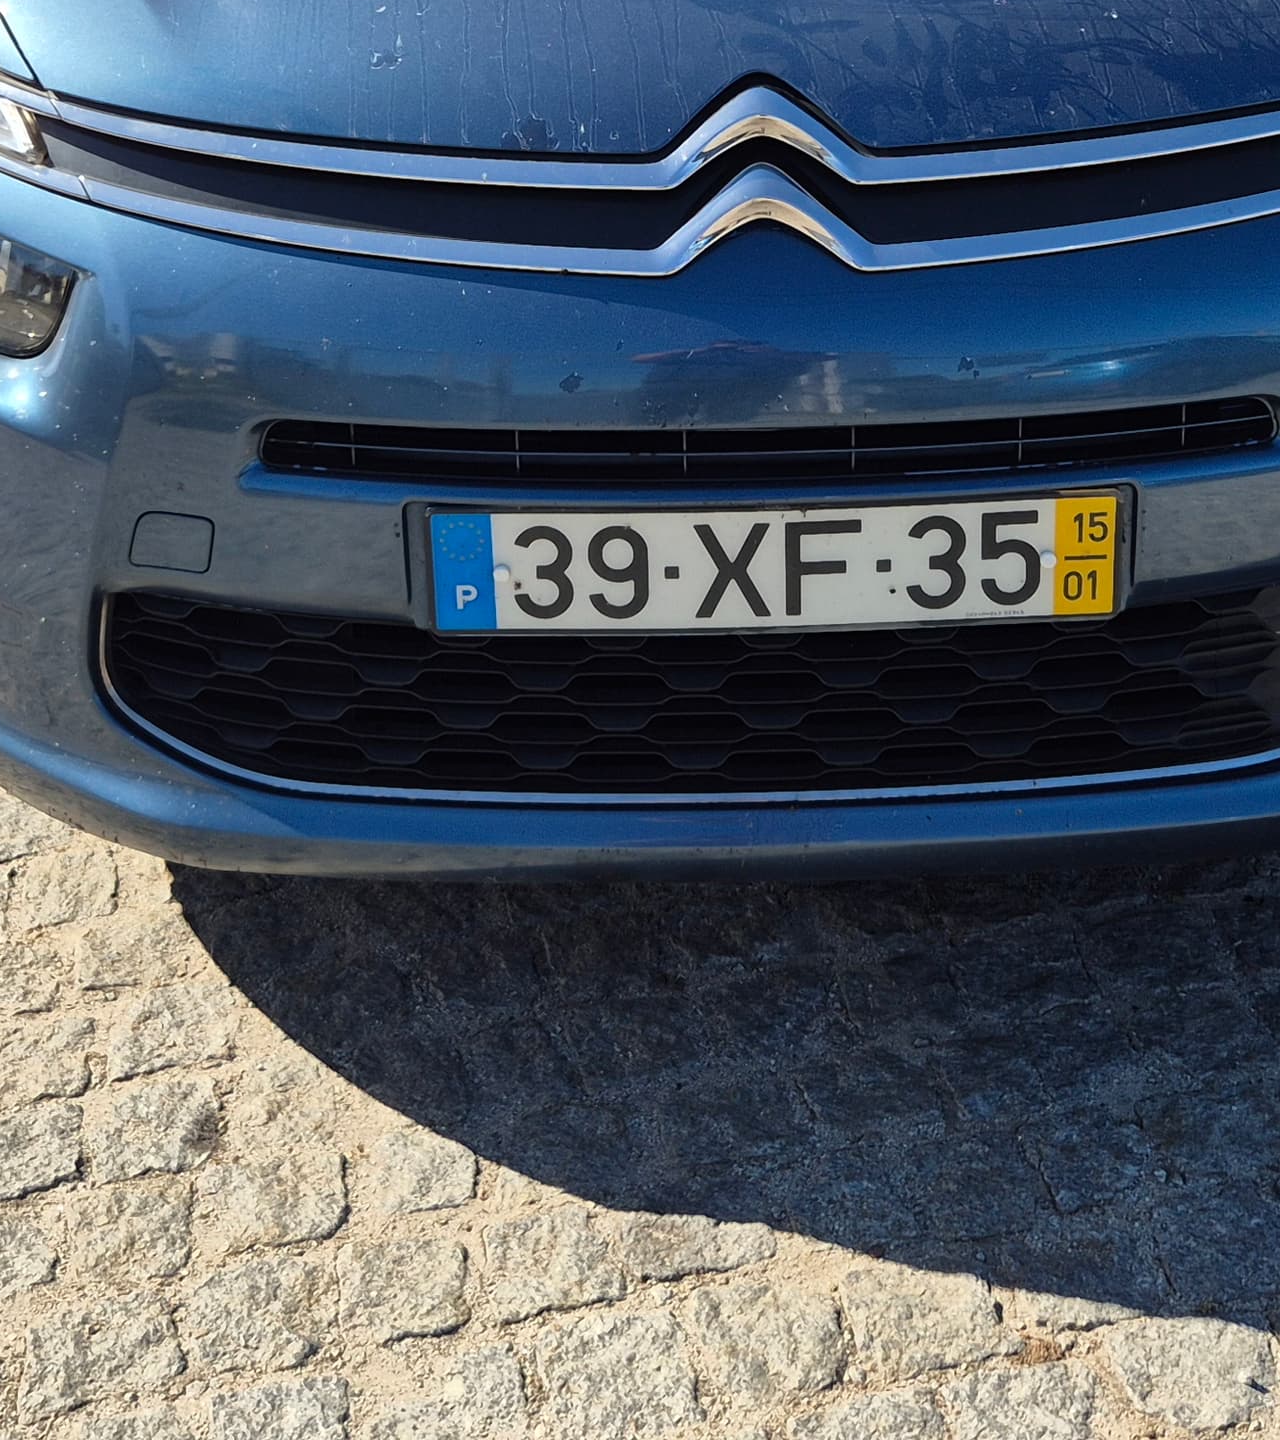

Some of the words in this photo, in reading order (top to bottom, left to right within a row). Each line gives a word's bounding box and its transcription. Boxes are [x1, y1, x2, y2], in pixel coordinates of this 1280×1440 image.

[1073, 512, 1108, 543] 15
[455, 584, 478, 610] P
[1063, 570, 1098, 601] 01
